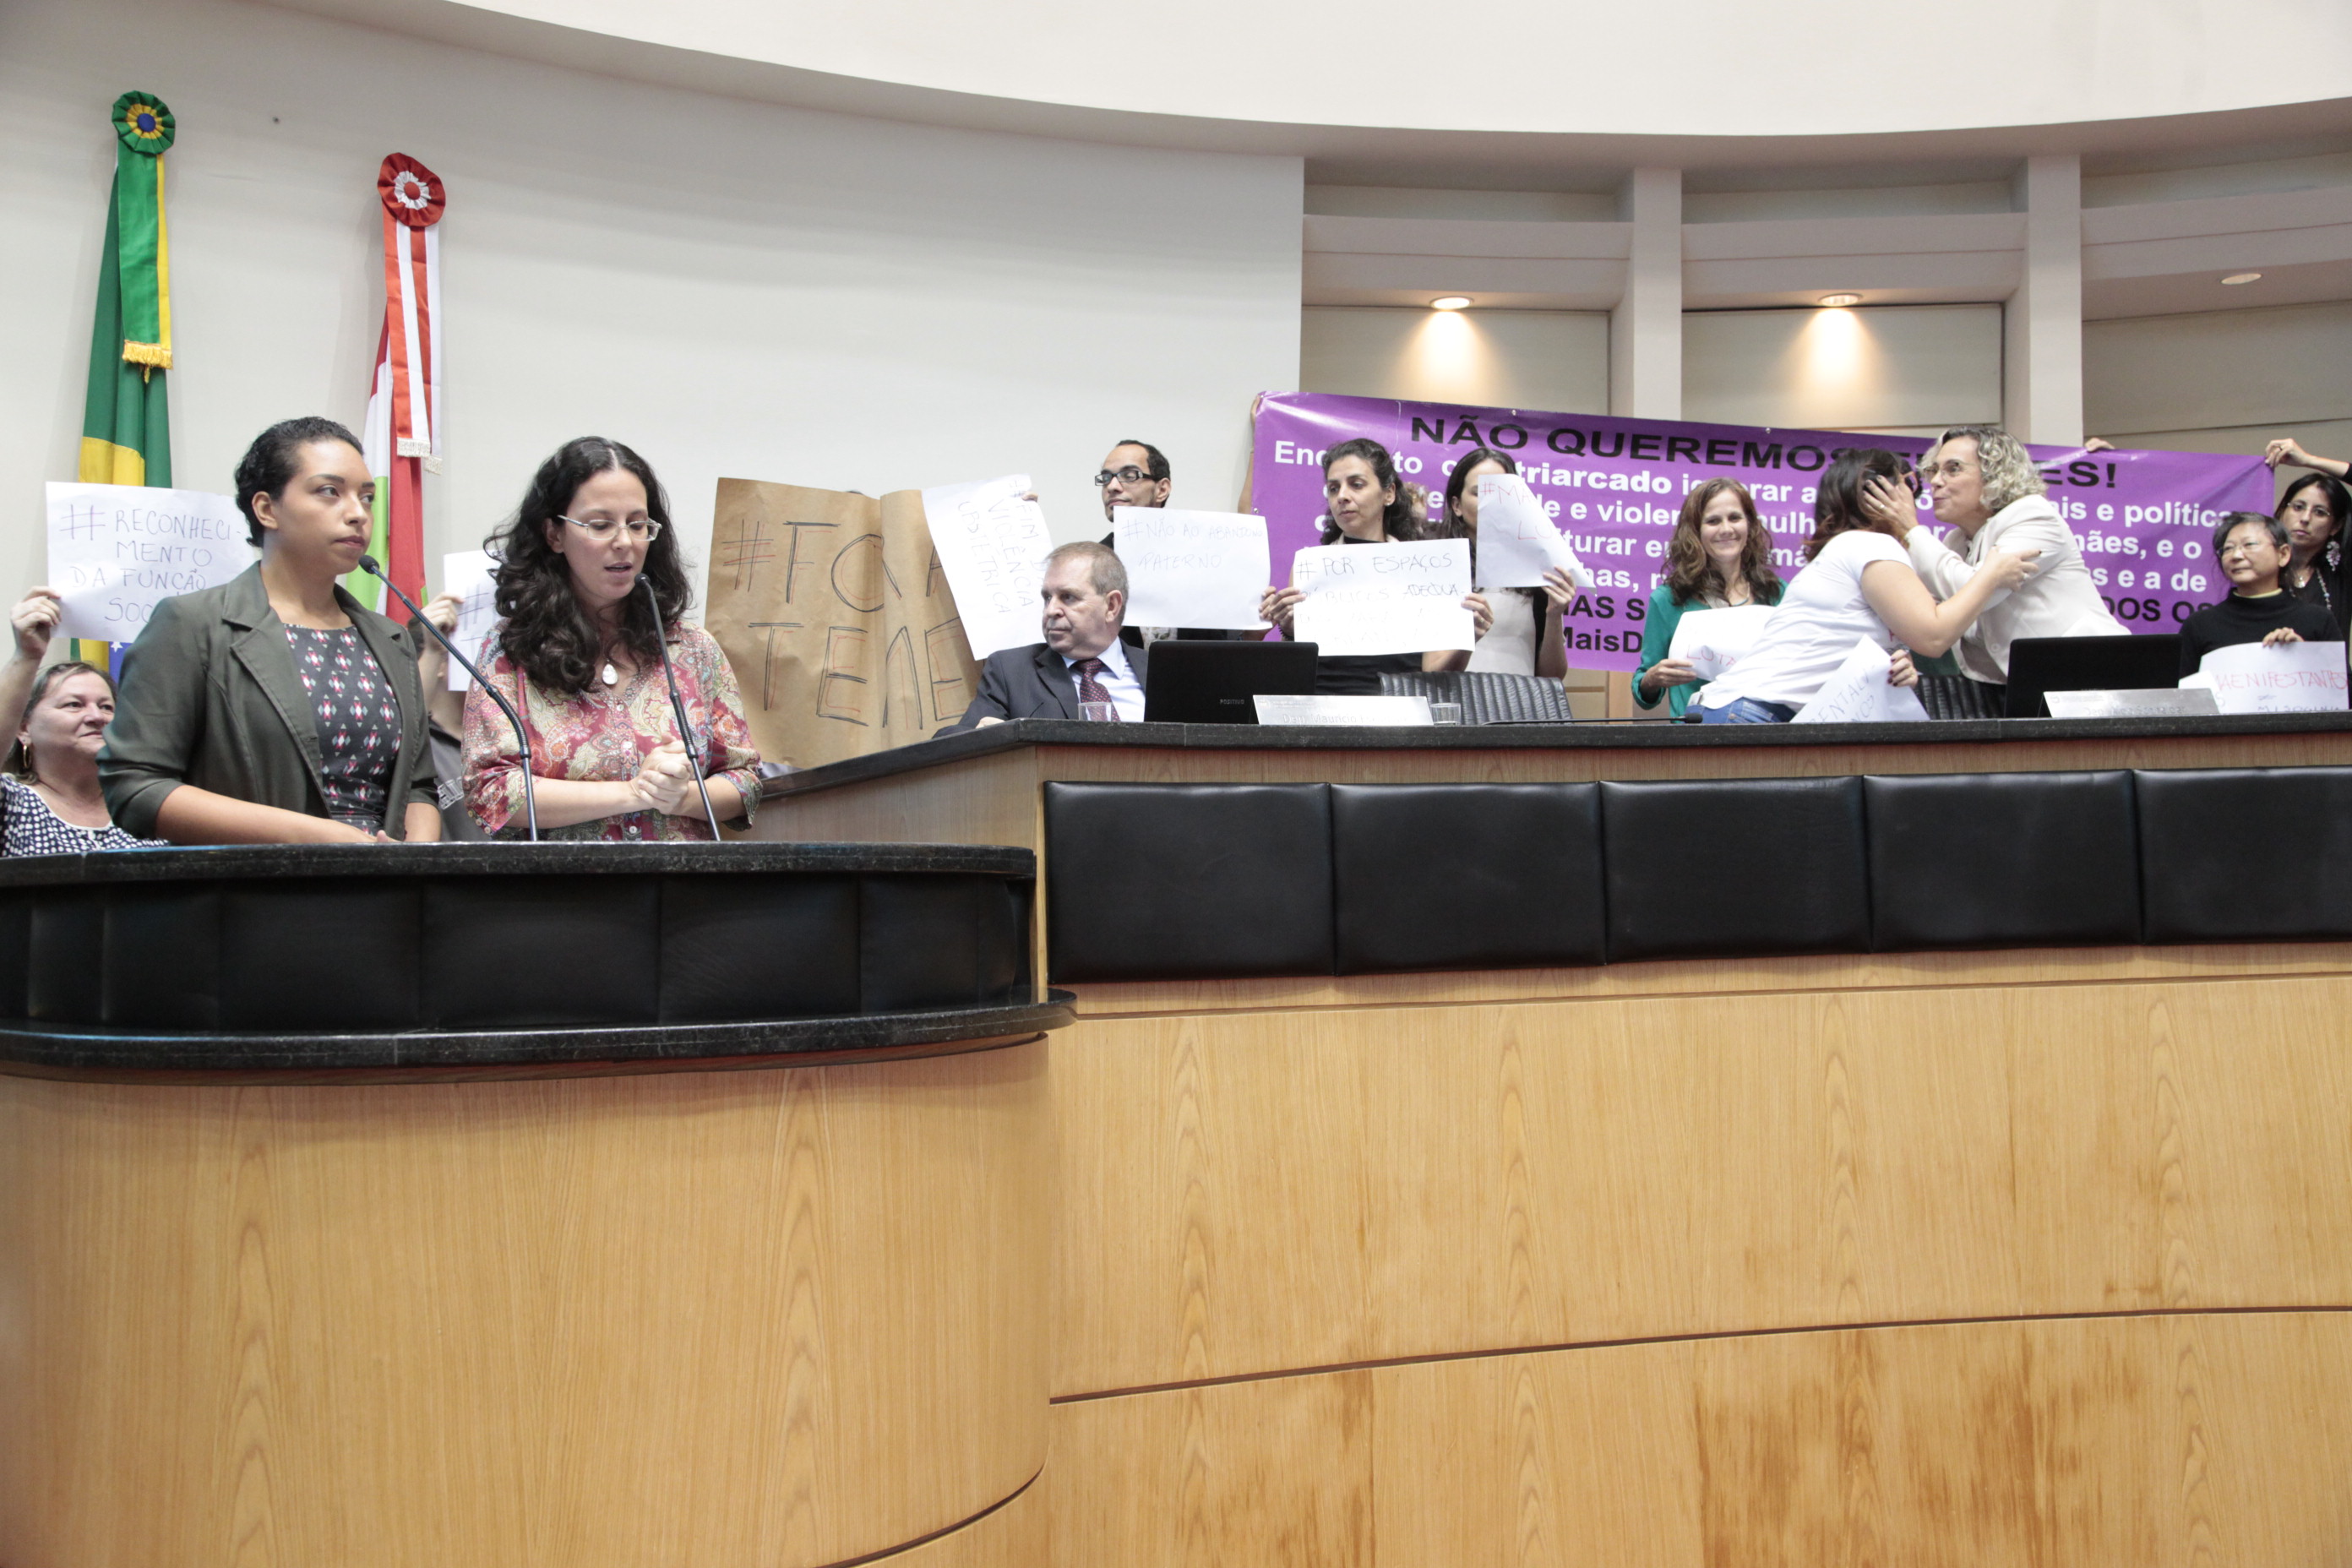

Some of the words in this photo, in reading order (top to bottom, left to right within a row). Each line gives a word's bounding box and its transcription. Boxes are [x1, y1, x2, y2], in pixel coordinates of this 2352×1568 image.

[1412, 414, 1528, 449] NÃO
[1547, 427, 1851, 471] QUEREMO
[1515, 461, 1673, 494] triarcado
[2096, 504, 2115, 521] e
[1183, 523, 1200, 541] AO
[1570, 501, 1587, 520] e
[2156, 539, 2175, 558] e
[2182, 542, 2202, 560] o
[117, 541, 212, 567] MENTO
[1138, 551, 1222, 572] PATERNO
[1372, 553, 1452, 574] ESPAÇOS
[70, 566, 108, 588] DA
[2117, 569, 2136, 588] e
[2143, 571, 2161, 590] a
[2170, 568, 2208, 593] de
[105, 597, 154, 623] SOC
